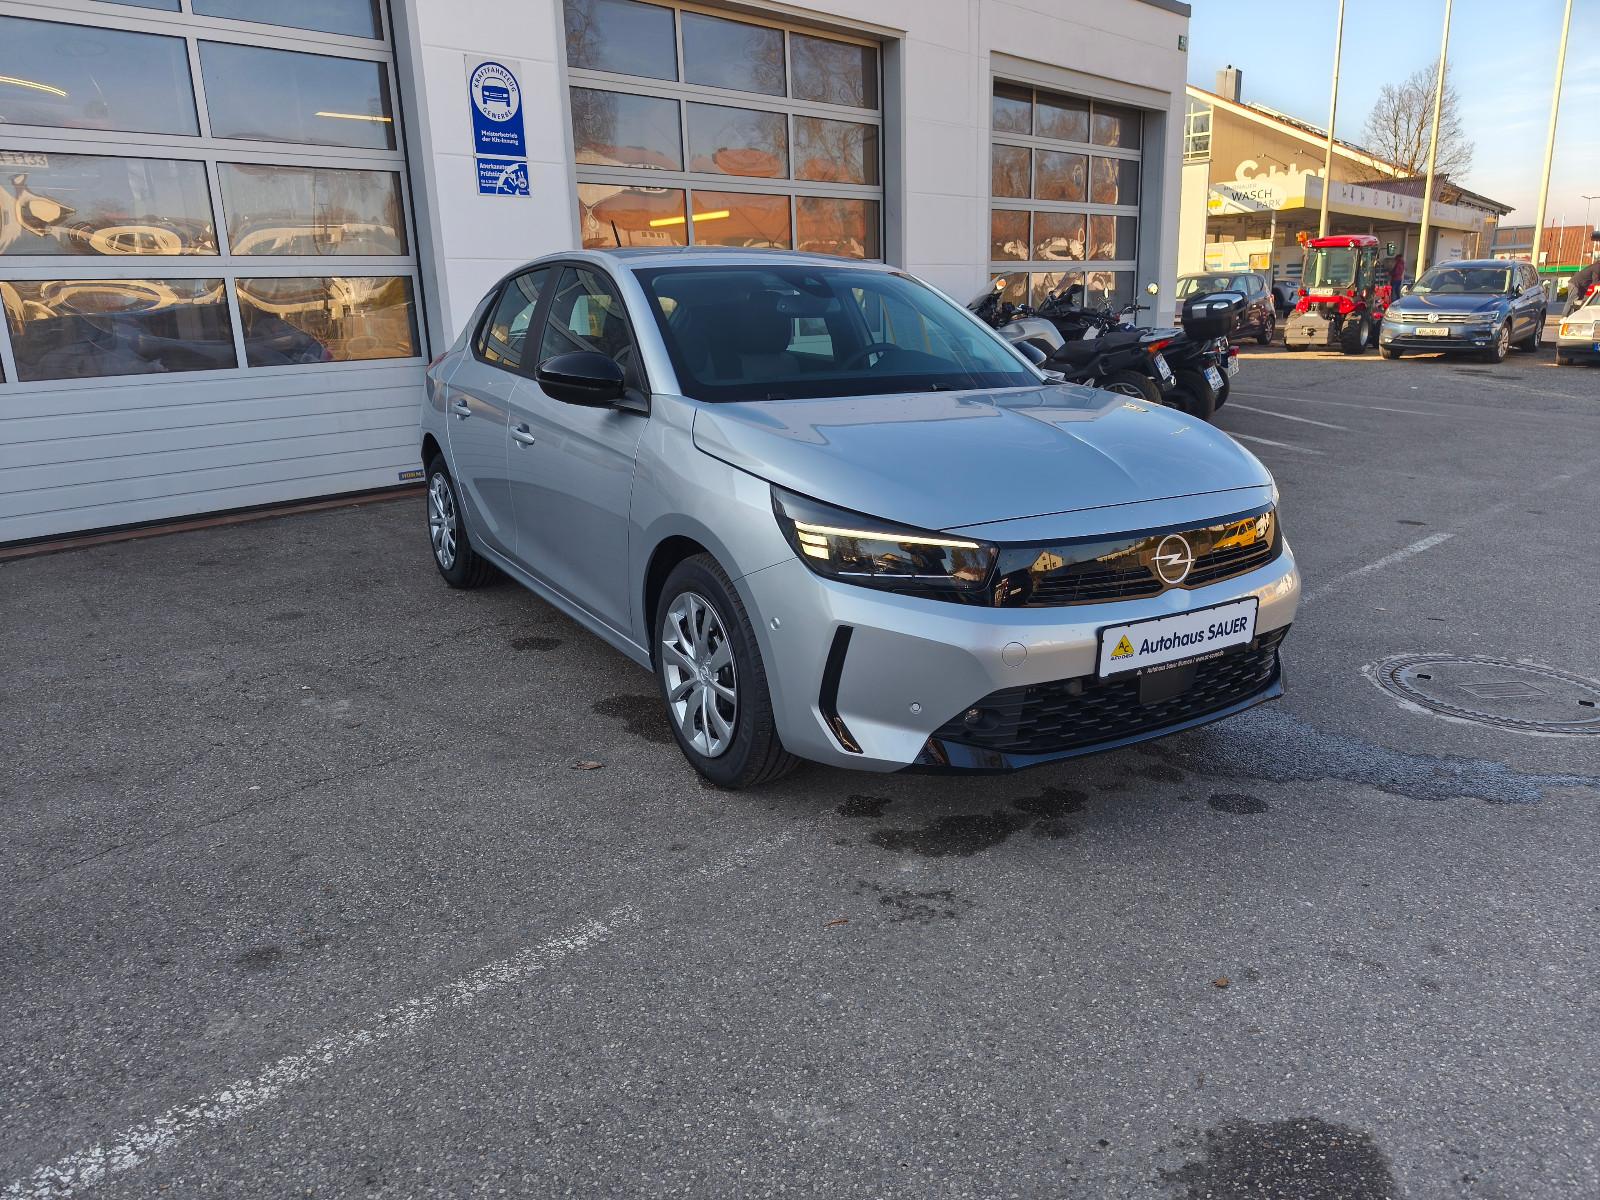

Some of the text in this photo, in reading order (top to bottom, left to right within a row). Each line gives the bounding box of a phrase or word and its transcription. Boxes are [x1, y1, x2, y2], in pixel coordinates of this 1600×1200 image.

[474, 66, 517, 93] KRAFTFAHRZEUG
[482, 107, 513, 120] GEWERBE
[1231, 188, 1273, 202] WASCH
[1256, 199, 1281, 209] PARK
[1138, 630, 1205, 656] Autohaus
[1207, 616, 1248, 641] SAUER
